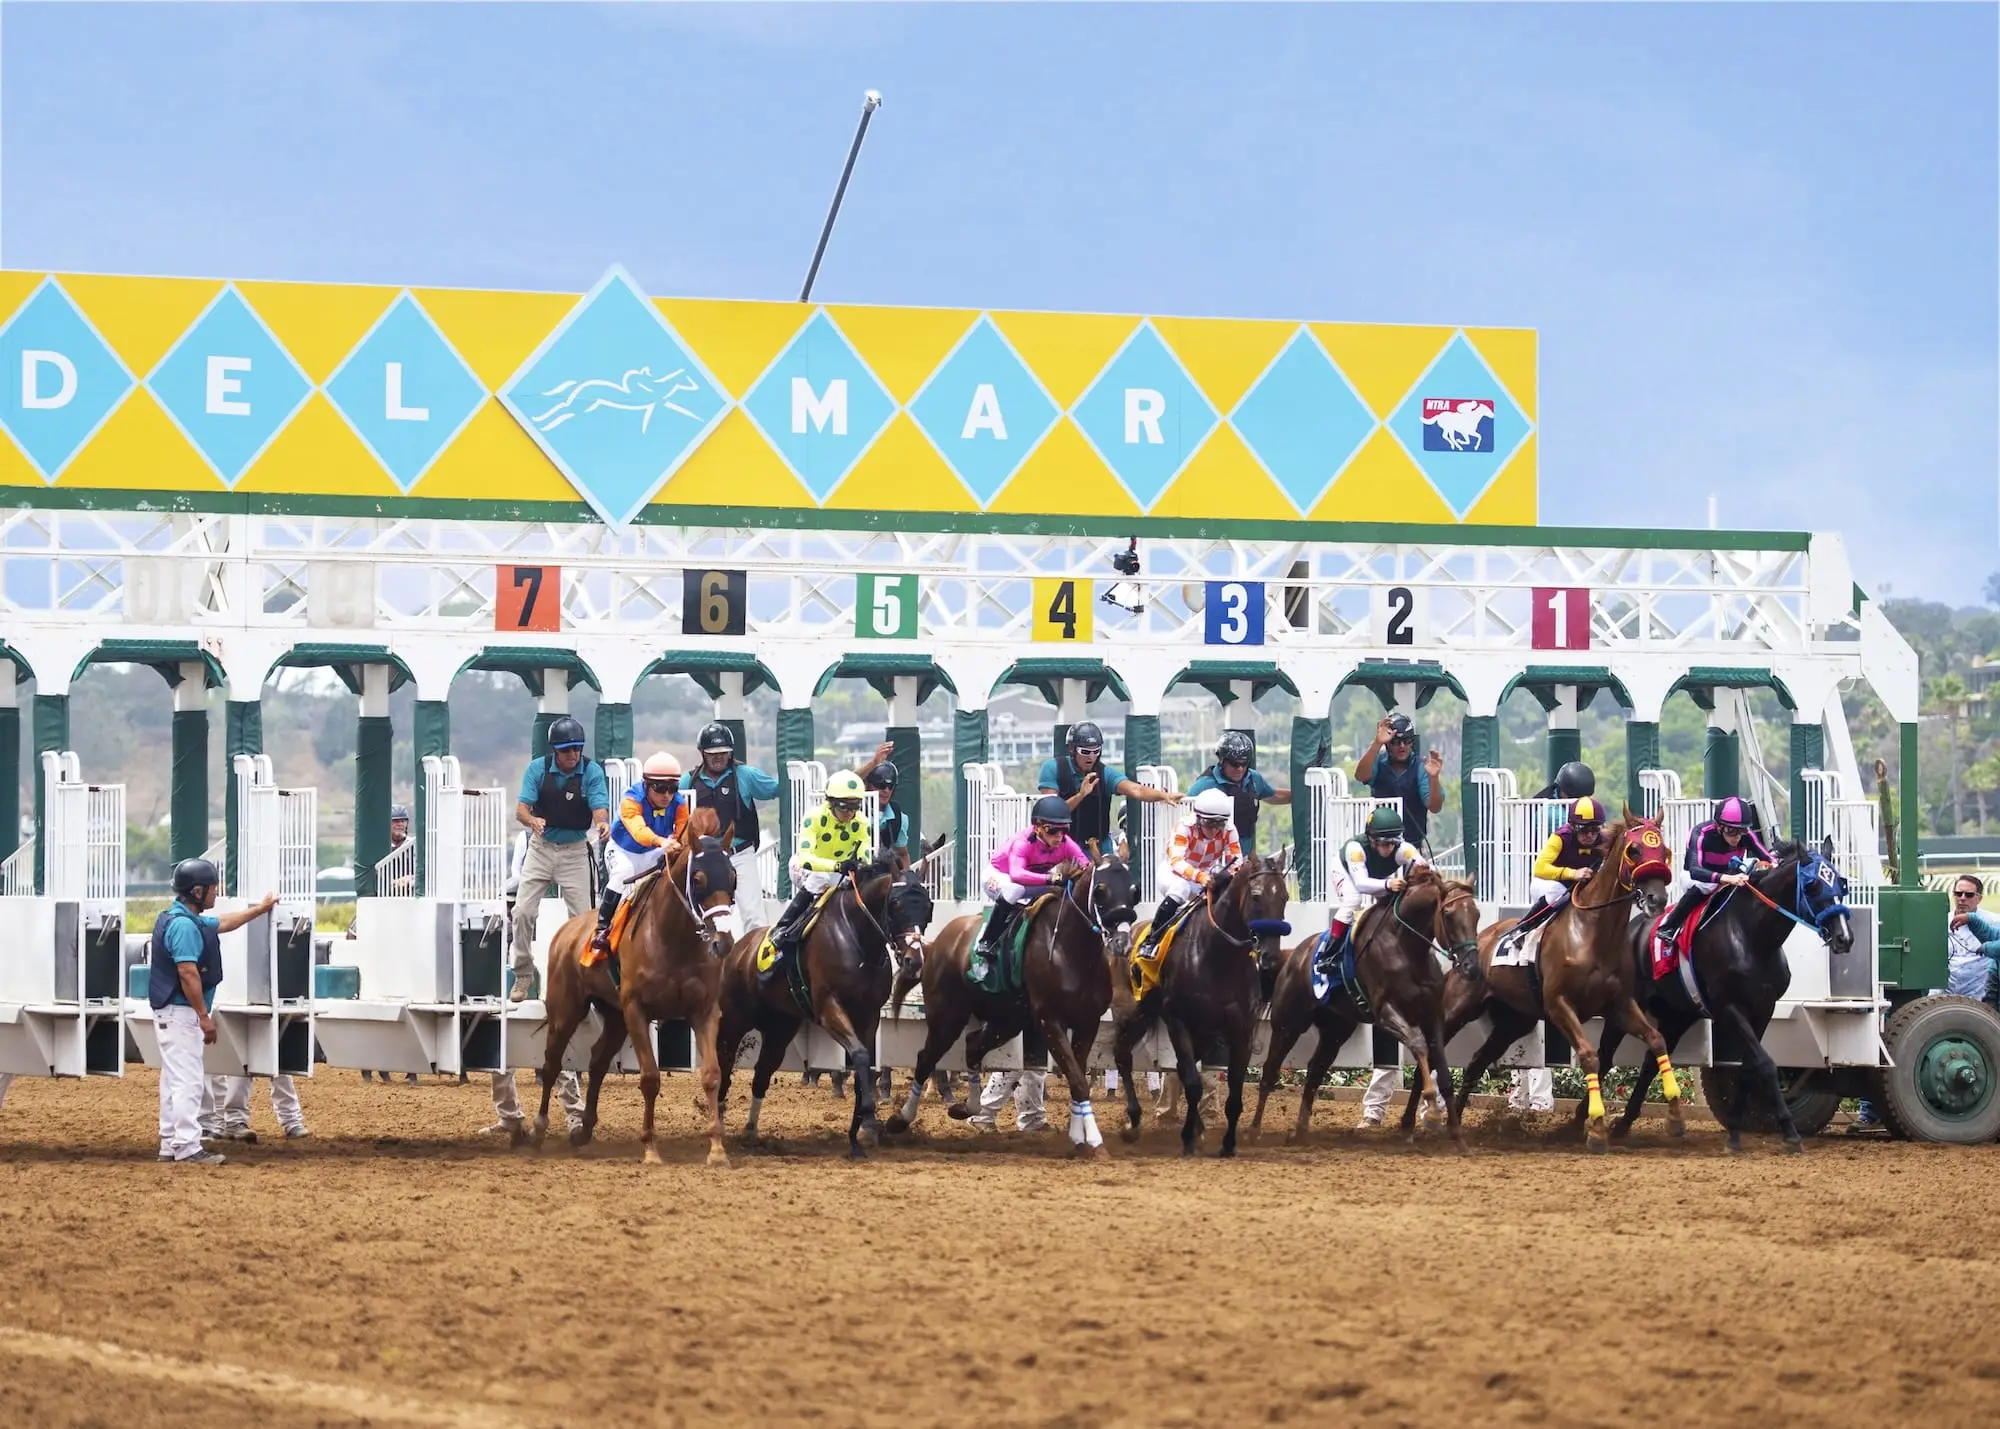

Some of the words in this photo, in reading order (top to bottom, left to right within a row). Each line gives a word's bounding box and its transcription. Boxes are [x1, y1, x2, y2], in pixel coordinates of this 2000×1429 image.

[1426, 400, 1450, 410] NTRA
[514, 568, 543, 627] 7
[700, 572, 729, 633] 6
[872, 576, 901, 636] 5
[1048, 581, 1077, 639] 4
[1220, 584, 1248, 642] 3
[1387, 587, 1413, 644] 2
[1547, 590, 1568, 649] 1
[1644, 832, 1658, 846] G
